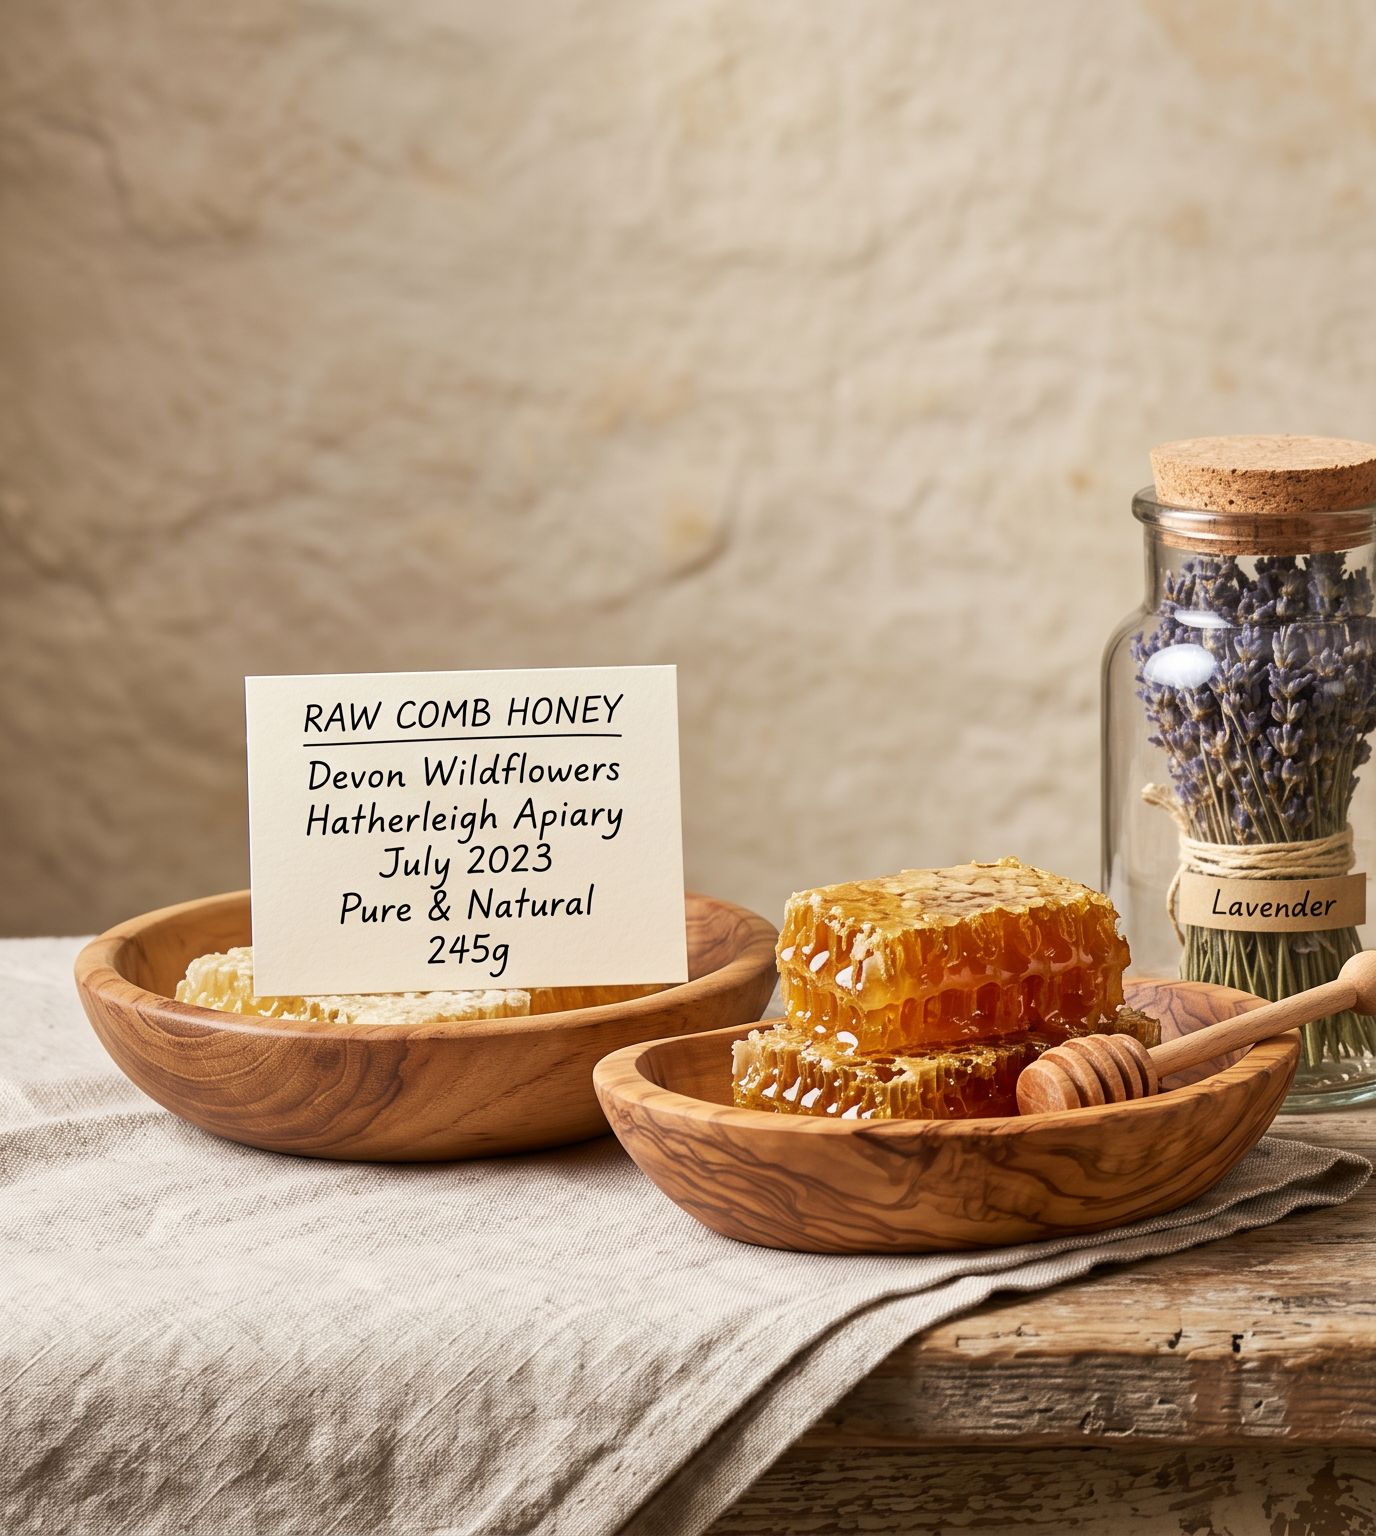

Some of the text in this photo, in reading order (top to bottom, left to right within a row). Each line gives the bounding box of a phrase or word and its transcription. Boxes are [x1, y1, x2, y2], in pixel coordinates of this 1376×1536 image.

[303, 693, 624, 733] RAW COMB HONEY
[308, 751, 620, 791] Devon Wildflowers
[306, 797, 623, 845] Hatherleigh Apiary
[378, 842, 552, 891] July 2023
[340, 883, 595, 925] Pure & Natural
[1212, 888, 1338, 918] Lavender
[427, 933, 510, 978] 245g
